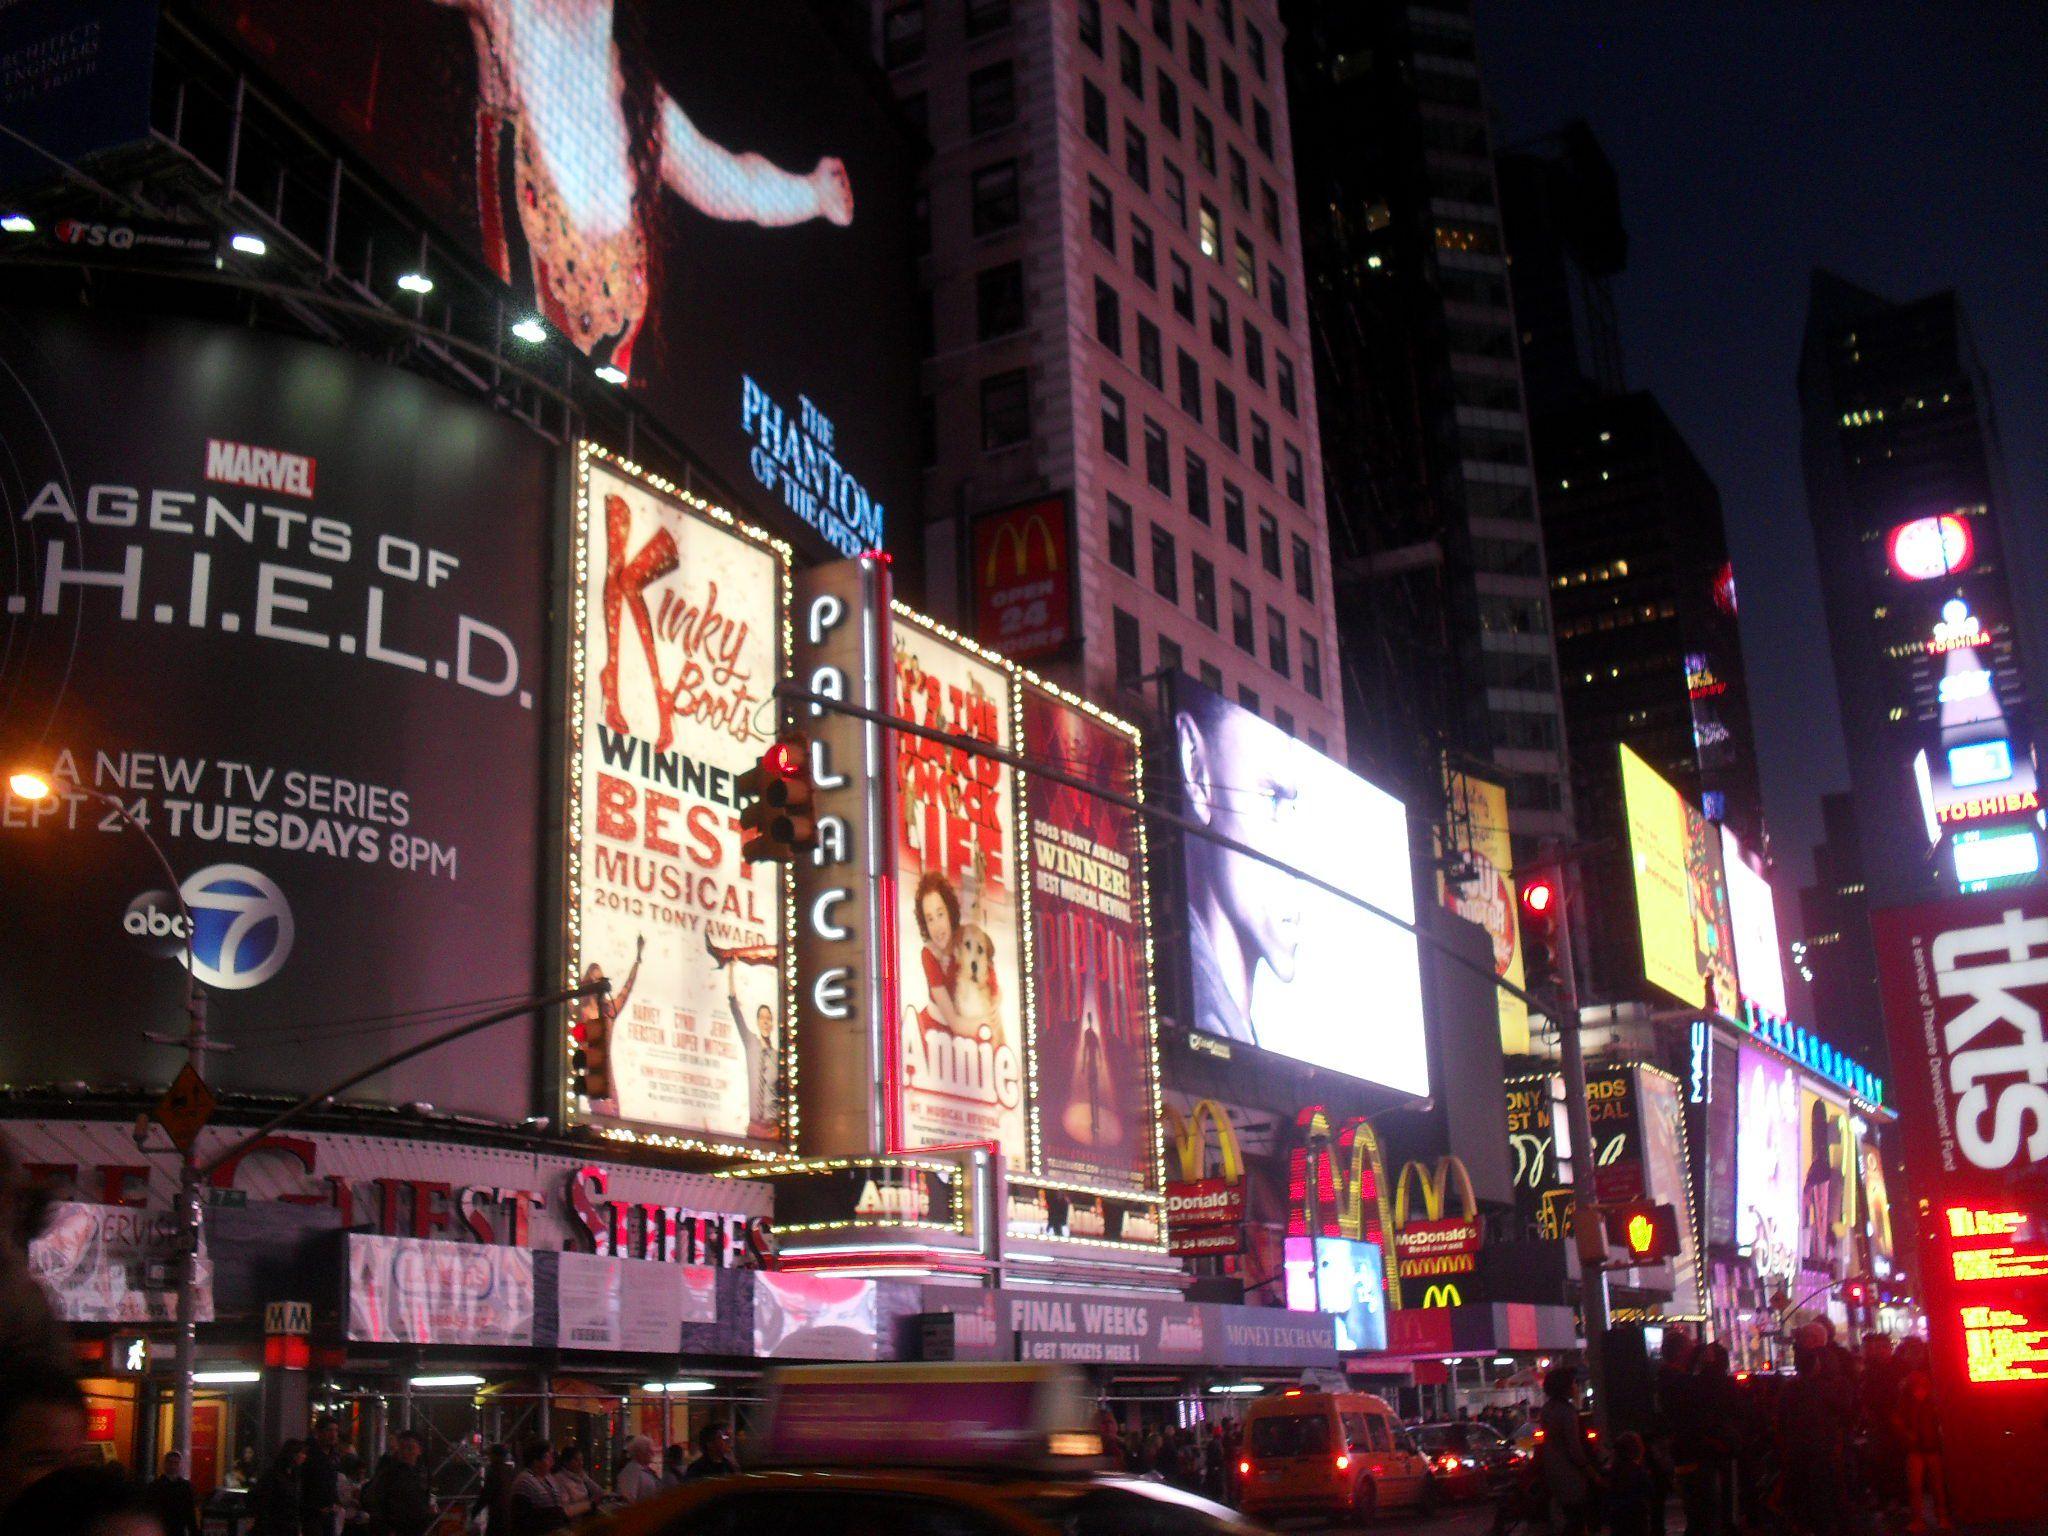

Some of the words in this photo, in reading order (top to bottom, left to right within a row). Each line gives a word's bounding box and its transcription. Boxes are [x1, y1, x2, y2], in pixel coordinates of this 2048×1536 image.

[798, 394, 835, 452] THE
[207, 440, 315, 498] MARVEL
[741, 373, 885, 553] PHANTOM
[751, 445, 777, 491] OF
[780, 470, 819, 528] THE
[22, 481, 353, 562] AGENTS
[378, 533, 460, 588] OF
[1000, 600, 1048, 636] 24
[1926, 631, 1992, 656] TOSHIBA
[670, 659, 766, 743] Boots
[949, 683, 999, 744] THE
[52, 748, 82, 785] A
[95, 751, 206, 794] NEW
[218, 761, 275, 803] TV
[284, 769, 410, 828] SERIES
[808, 594, 849, 1020] PALACE
[1938, 791, 2039, 824] TOSHIBA
[100, 798, 151, 832] 24
[165, 800, 380, 863] TUESDAYS
[390, 833, 457, 880] 8PM
[896, 795, 1005, 890] LIFE
[1060, 829, 1092, 855] TONY
[595, 844, 765, 925] MUSICAL
[1033, 837, 1131, 901] WINNER!
[1036, 869, 1060, 897] BEST
[123, 904, 194, 939] abc
[595, 888, 644, 917] 2013
[649, 902, 698, 931] TONY
[1036, 911, 1137, 1044] PIPPIN
[903, 1004, 1021, 1110] Annie
[1932, 907, 2048, 1171] tkts
[1585, 1078, 1627, 1100] RDS
[1929, 1056, 1952, 1139] Development
[856, 1178, 931, 1218] Annie
[1164, 1190, 1241, 1211] cDonald's
[1197, 1235, 1237, 1249] HOURS
[1395, 1226, 1478, 1246] McDonald's
[952, 1308, 998, 1348] nnie
[1011, 1299, 1077, 1333] FINAL
[1081, 1304, 1149, 1337] WEEKS
[1227, 1324, 1270, 1348] MONEY
[1272, 1325, 1335, 1349] EXCHANGE
[1033, 1341, 1057, 1360] GET
[1060, 1341, 1100, 1361] TICKETS
[1102, 1345, 1132, 1362] HERE
